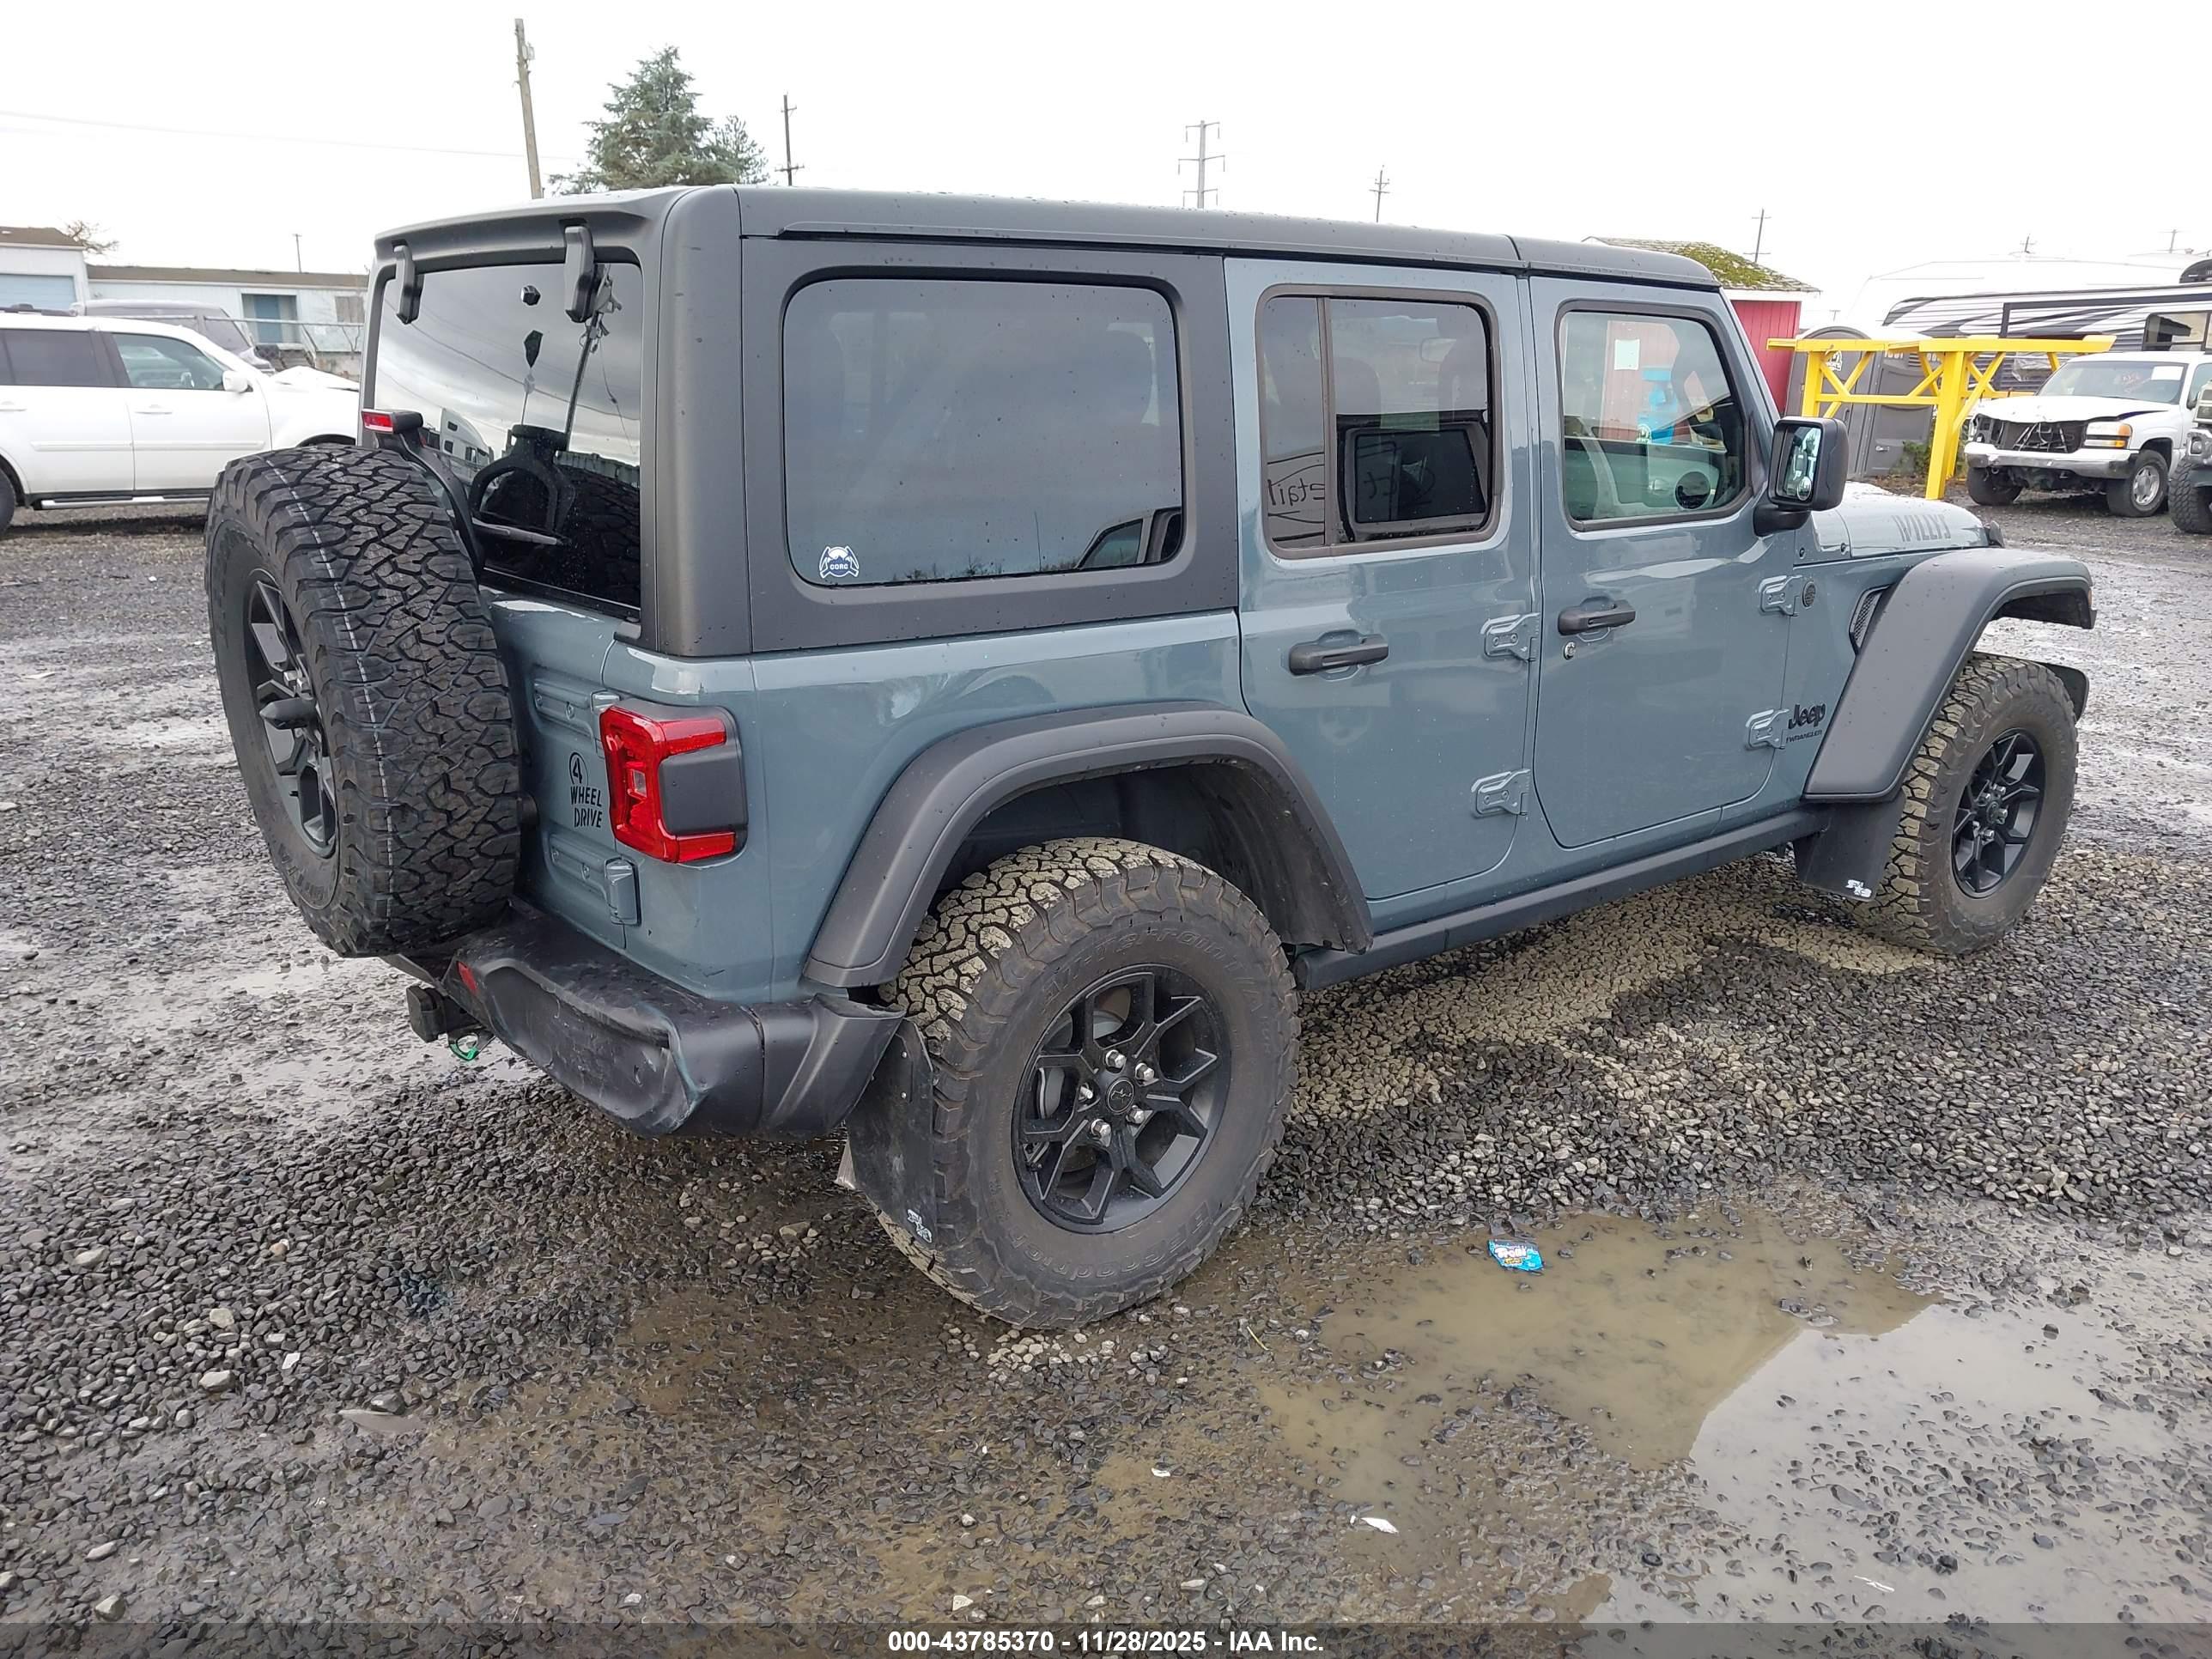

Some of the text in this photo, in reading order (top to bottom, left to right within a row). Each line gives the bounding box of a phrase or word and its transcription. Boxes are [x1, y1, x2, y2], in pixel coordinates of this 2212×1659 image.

[1891, 513, 1952, 543] WILLYS
[1788, 704, 1826, 729] Jeep
[570, 786, 602, 807] WHEEL
[574, 807, 603, 828] DRIVE
